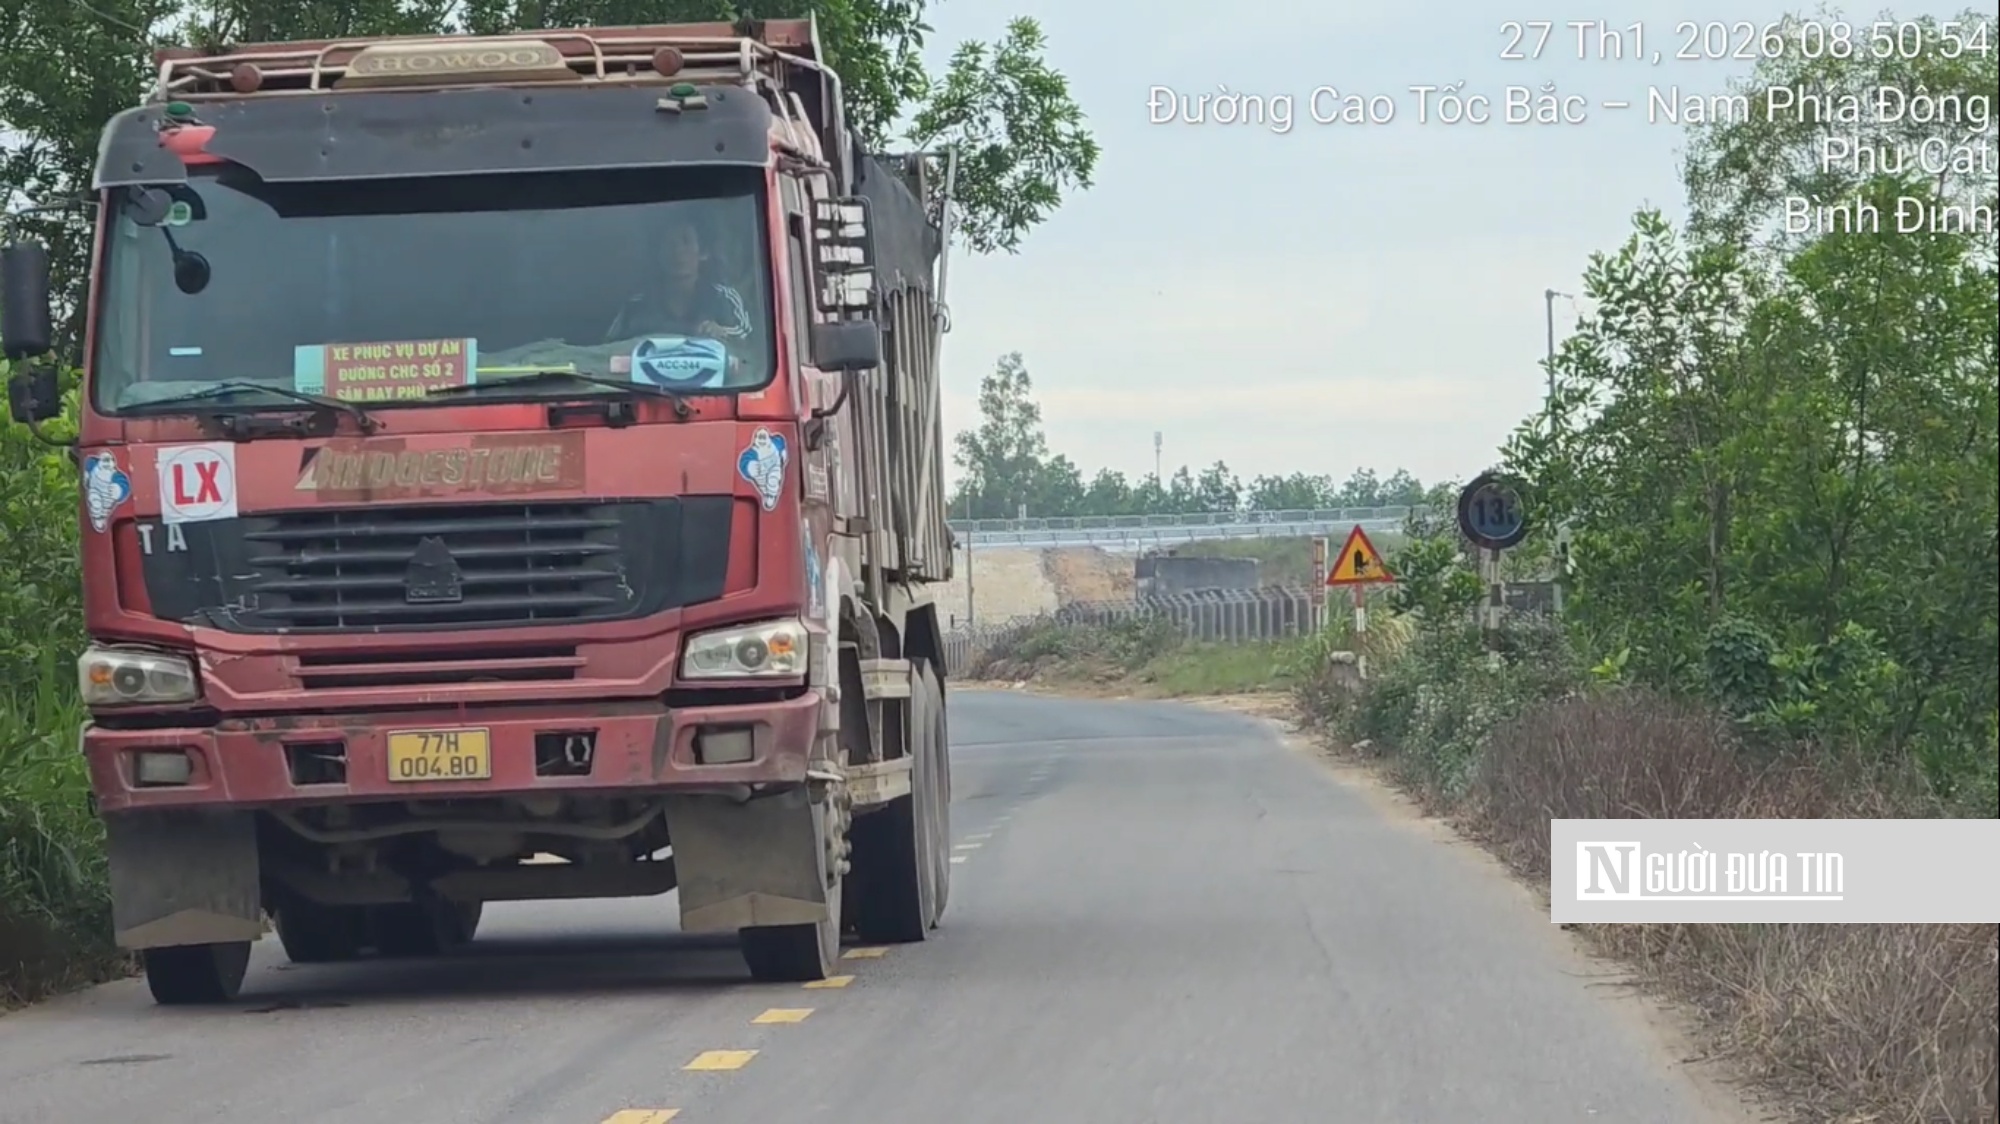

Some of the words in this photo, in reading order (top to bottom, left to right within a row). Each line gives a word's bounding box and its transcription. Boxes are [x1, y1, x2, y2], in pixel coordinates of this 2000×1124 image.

[333, 347, 349, 360] XE
[354, 345, 391, 361] PHỤC
[395, 343, 414, 359] VỤ
[389, 365, 418, 380] CHC
[423, 358, 441, 377] SỐ
[445, 362, 454, 376] 2
[173, 461, 222, 506] LX
[137, 524, 154, 554] T
[168, 523, 187, 552] A
[417, 732, 459, 754] 77H
[400, 755, 477, 777] 004.80
